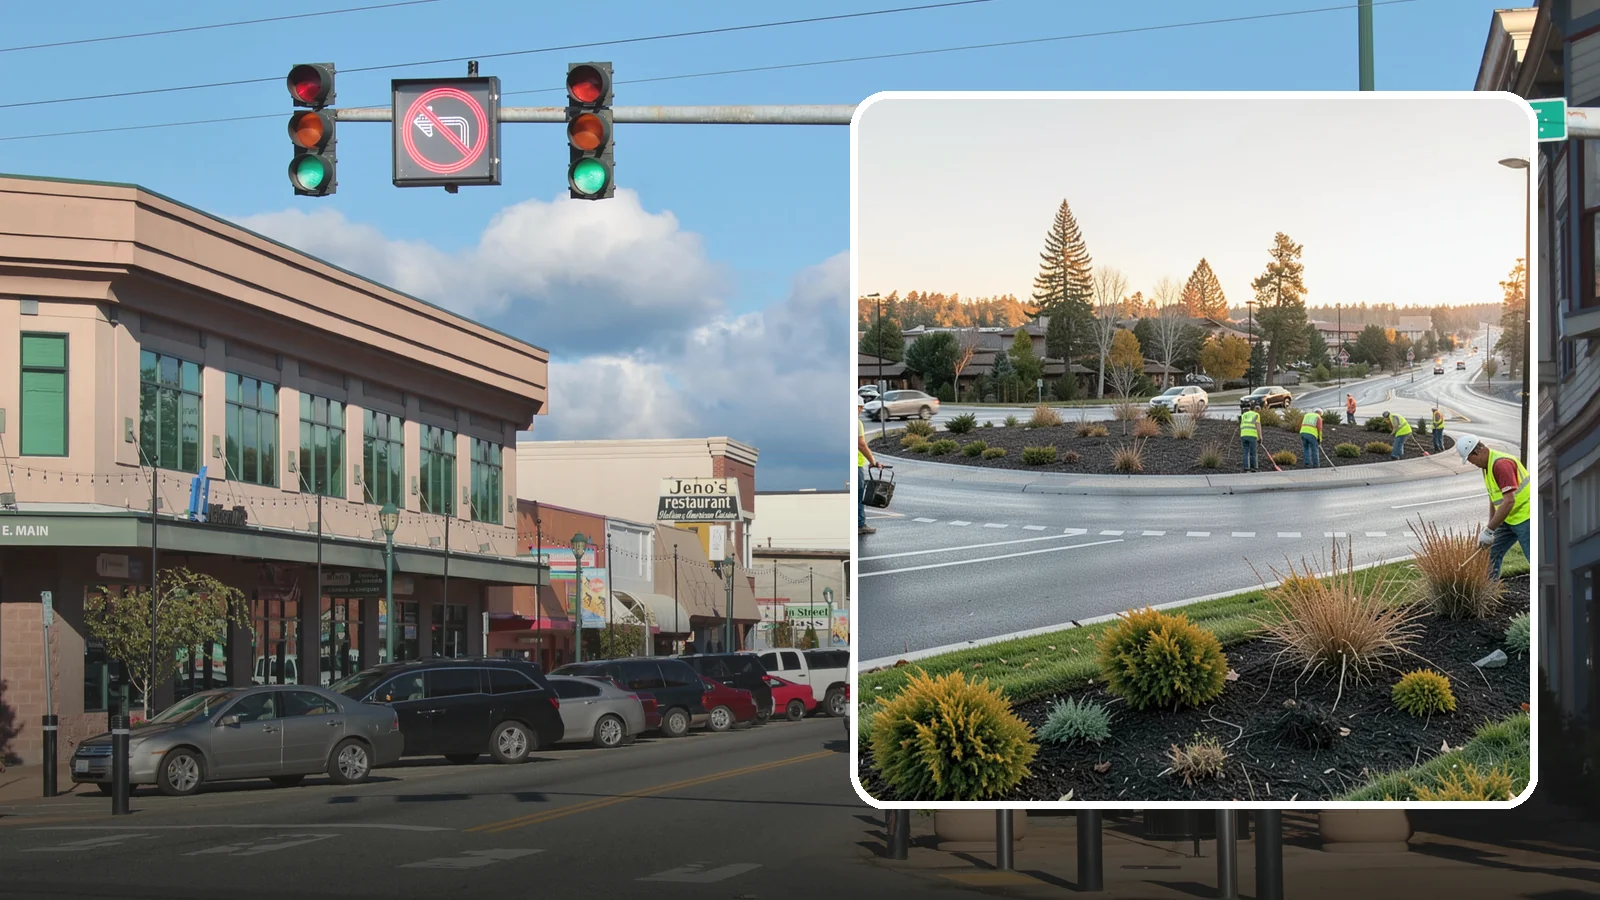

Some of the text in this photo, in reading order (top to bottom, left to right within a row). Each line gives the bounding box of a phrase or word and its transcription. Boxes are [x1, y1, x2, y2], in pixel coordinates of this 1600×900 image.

[670, 480, 727, 494] Jeno's
[665, 496, 731, 509] restaurant
[659, 510, 681, 519] Italian
[686, 510, 714, 519] American
[715, 509, 737, 519] Cuisine
[2, 525, 49, 536] E. MAIN
[797, 607, 829, 617] Street
